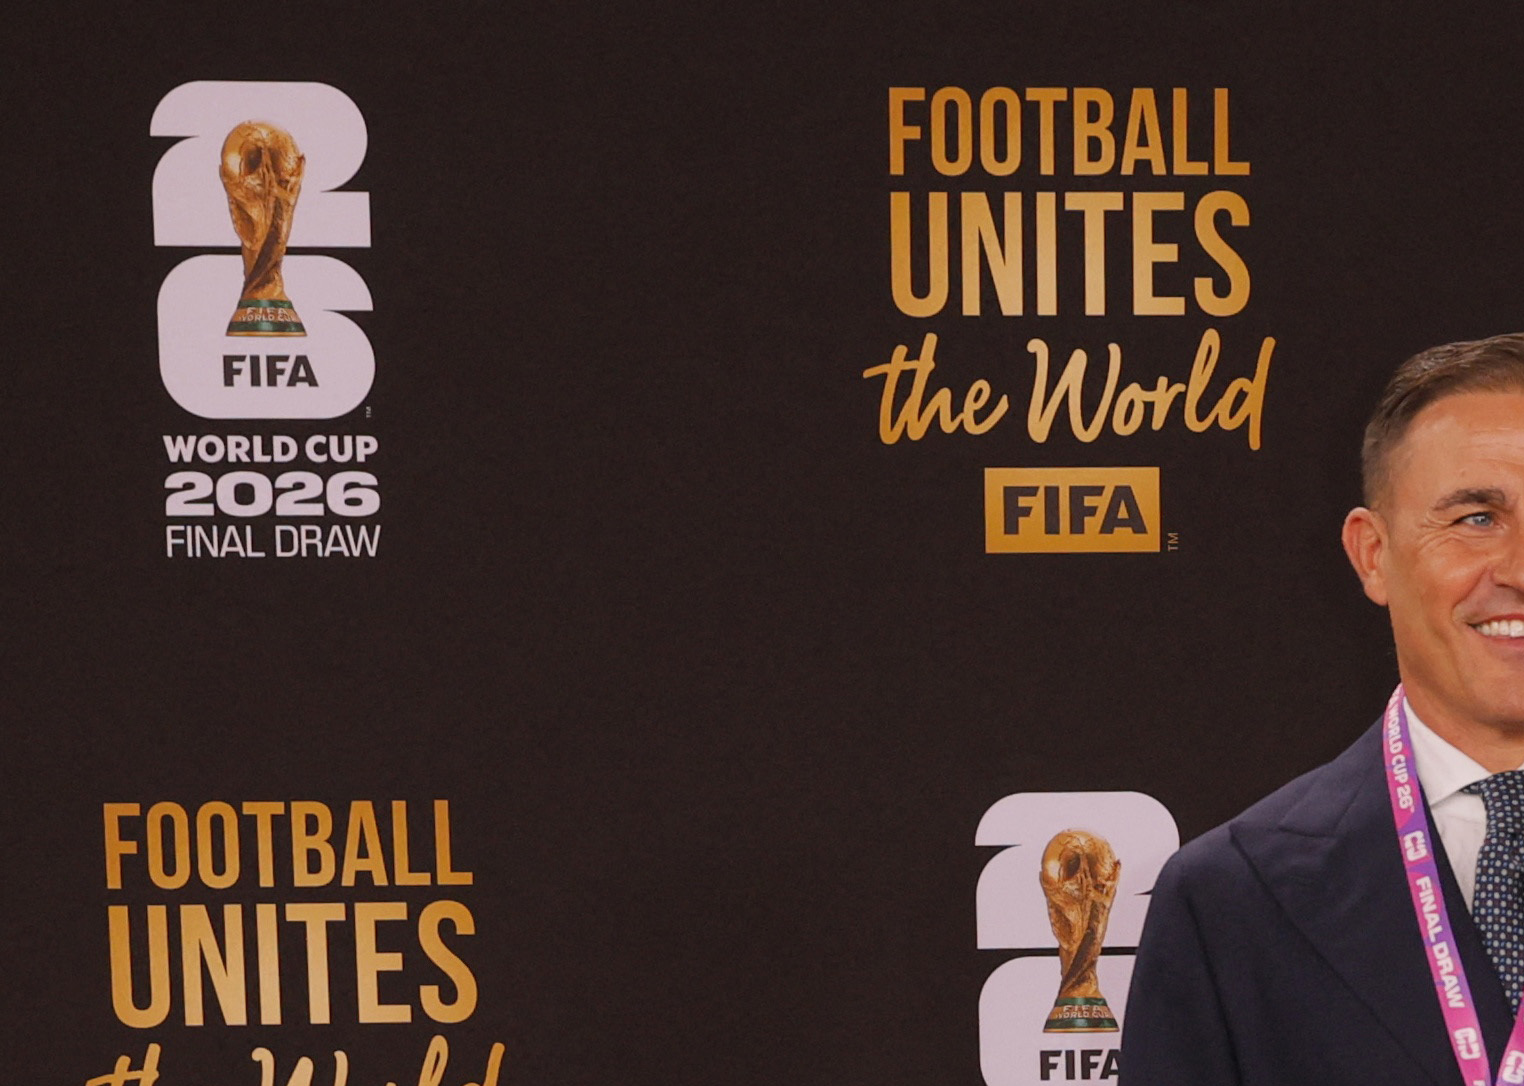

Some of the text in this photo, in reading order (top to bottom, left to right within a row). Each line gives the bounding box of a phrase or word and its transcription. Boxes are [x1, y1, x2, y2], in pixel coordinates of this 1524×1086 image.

[889, 87, 1250, 176] FOOTBALL
[890, 191, 1250, 317] UNITES
[223, 355, 319, 386] FIFA
[863, 328, 1276, 451] the World
[163, 435, 378, 463] WORLD CUP
[165, 471, 380, 516] 2026
[1003, 486, 1148, 535] FIFA
[166, 525, 380, 557] FINAL DRAW
[1391, 754, 1409, 784] CUP
[104, 800, 473, 890] FOOTBALL
[108, 900, 477, 1028] UNITES
[1415, 876, 1443, 942] FINAL
[1431, 941, 1465, 1009] DRAW
[1040, 1049, 1121, 1081] FIFA
